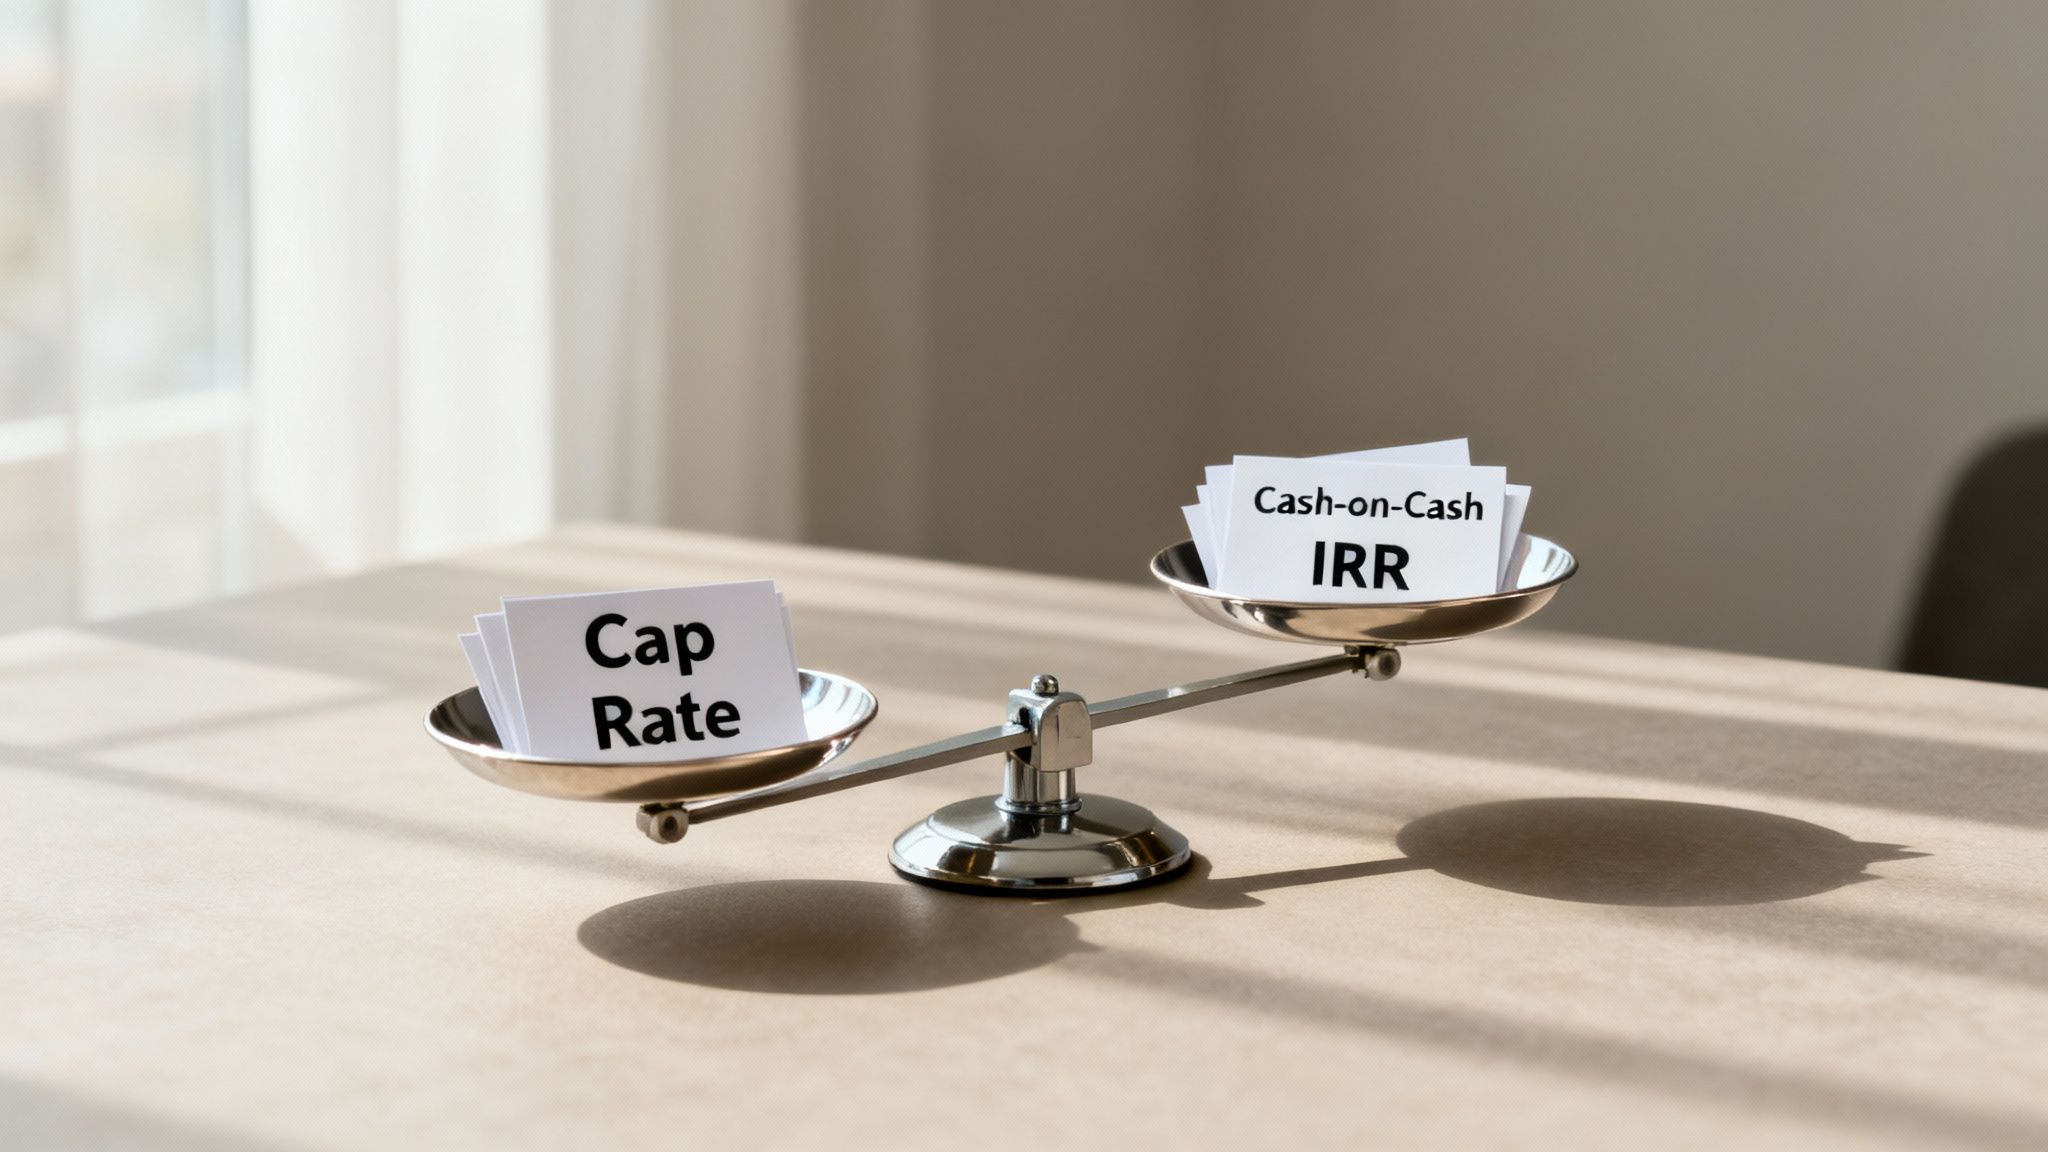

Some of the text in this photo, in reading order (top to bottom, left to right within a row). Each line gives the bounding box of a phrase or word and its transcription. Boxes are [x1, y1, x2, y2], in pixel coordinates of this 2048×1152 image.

[1254, 486, 1484, 521] Cash-on-Cash
[1312, 540, 1410, 591] IRR
[584, 612, 715, 677] Cap
[591, 691, 741, 751] Rate
